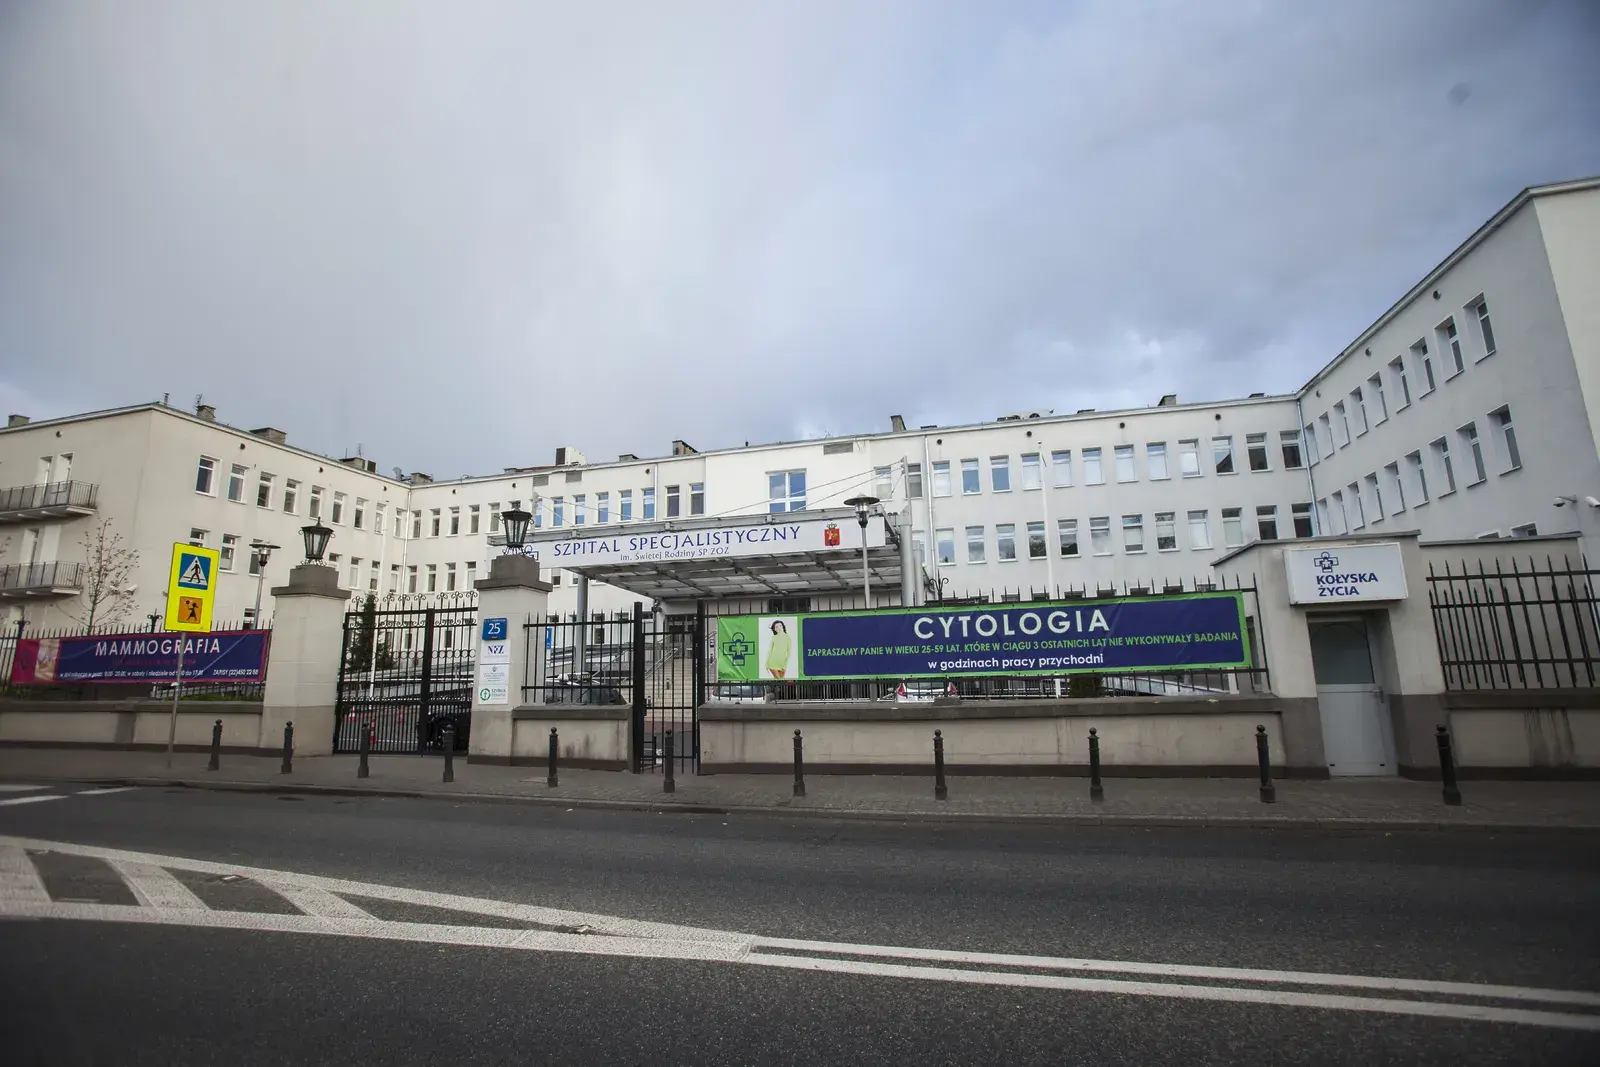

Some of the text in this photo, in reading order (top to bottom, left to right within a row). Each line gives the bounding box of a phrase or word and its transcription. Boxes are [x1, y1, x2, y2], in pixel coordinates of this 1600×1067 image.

[554, 525, 801, 557] SZPITAL SPECJALISTYCZNY
[635, 550, 662, 561] Świętej
[664, 549, 696, 559] Rodziny
[710, 546, 730, 555] ZOZ
[1316, 572, 1379, 585] KOŁYSKA
[1318, 585, 1360, 597] ŻYCIA
[487, 622, 501, 635] 25
[914, 609, 1110, 639] CYTOLOGIA
[95, 638, 221, 657] MAMMOGRAFIA
[487, 645, 505, 655] NFZ
[807, 631, 1239, 657] ZAPRASZAMY PANIE W WIEKU 25-59 LAT, KTÓRE W CIĄGU 3 OSTATNICH LAT NIE WYKONYWAŁY BADANIA
[928, 653, 1104, 671] w godzinach pracy przychodni
